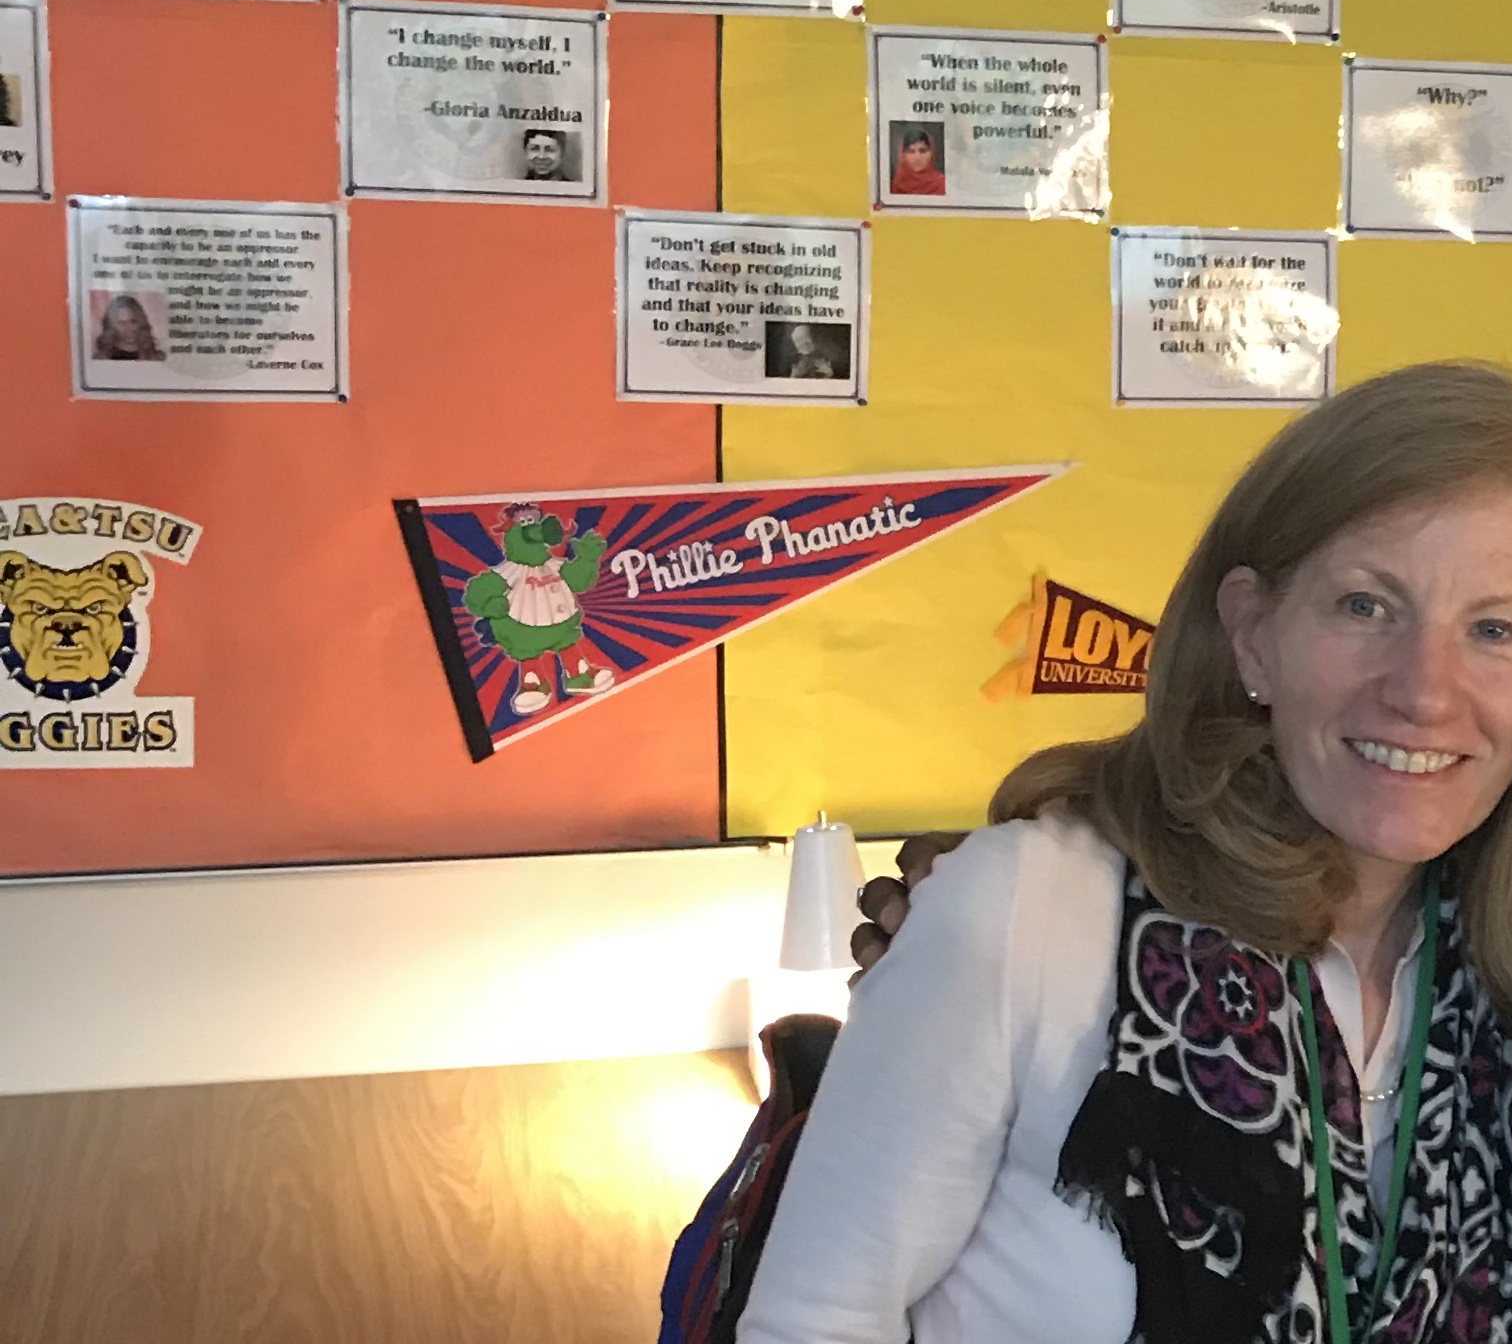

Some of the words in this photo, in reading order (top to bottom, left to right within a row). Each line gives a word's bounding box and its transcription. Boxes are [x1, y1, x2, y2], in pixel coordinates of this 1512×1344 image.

[412, 29, 484, 51] change
[489, 34, 558, 54] myself,
[387, 52, 459, 73] change
[465, 55, 495, 72] the
[502, 58, 571, 76] world."
[985, 55, 1012, 71] the
[1017, 57, 1068, 74] whole
[907, 76, 956, 92] world
[962, 78, 977, 93] is
[983, 78, 1036, 96] silent,
[1042, 83, 1081, 97] even
[912, 100, 944, 113] one
[950, 100, 995, 116] voice
[710, 240, 736, 256] get
[742, 241, 786, 256] stuck
[792, 243, 807, 257] in
[812, 244, 836, 258] old
[645, 256, 694, 272] ideas.
[701, 259, 742, 276] Keep
[747, 263, 842, 281] recognizing
[1252, 255, 1276, 269] for
[1280, 256, 1306, 270] the
[648, 277, 681, 292] that
[687, 279, 739, 296] reality
[745, 280, 759, 294] is
[764, 282, 839, 300] changing
[642, 298, 672, 311] and
[678, 299, 711, 312] that
[716, 301, 755, 317] your
[759, 302, 803, 317] ideas
[808, 304, 845, 318] have
[653, 318, 669, 332] to
[1160, 339, 1205, 353] catch
[0, 502, 192, 553] A&TSU
[611, 540, 744, 598] Phillie
[745, 496, 922, 565] Phanatic
[1044, 595, 1152, 670] LOY
